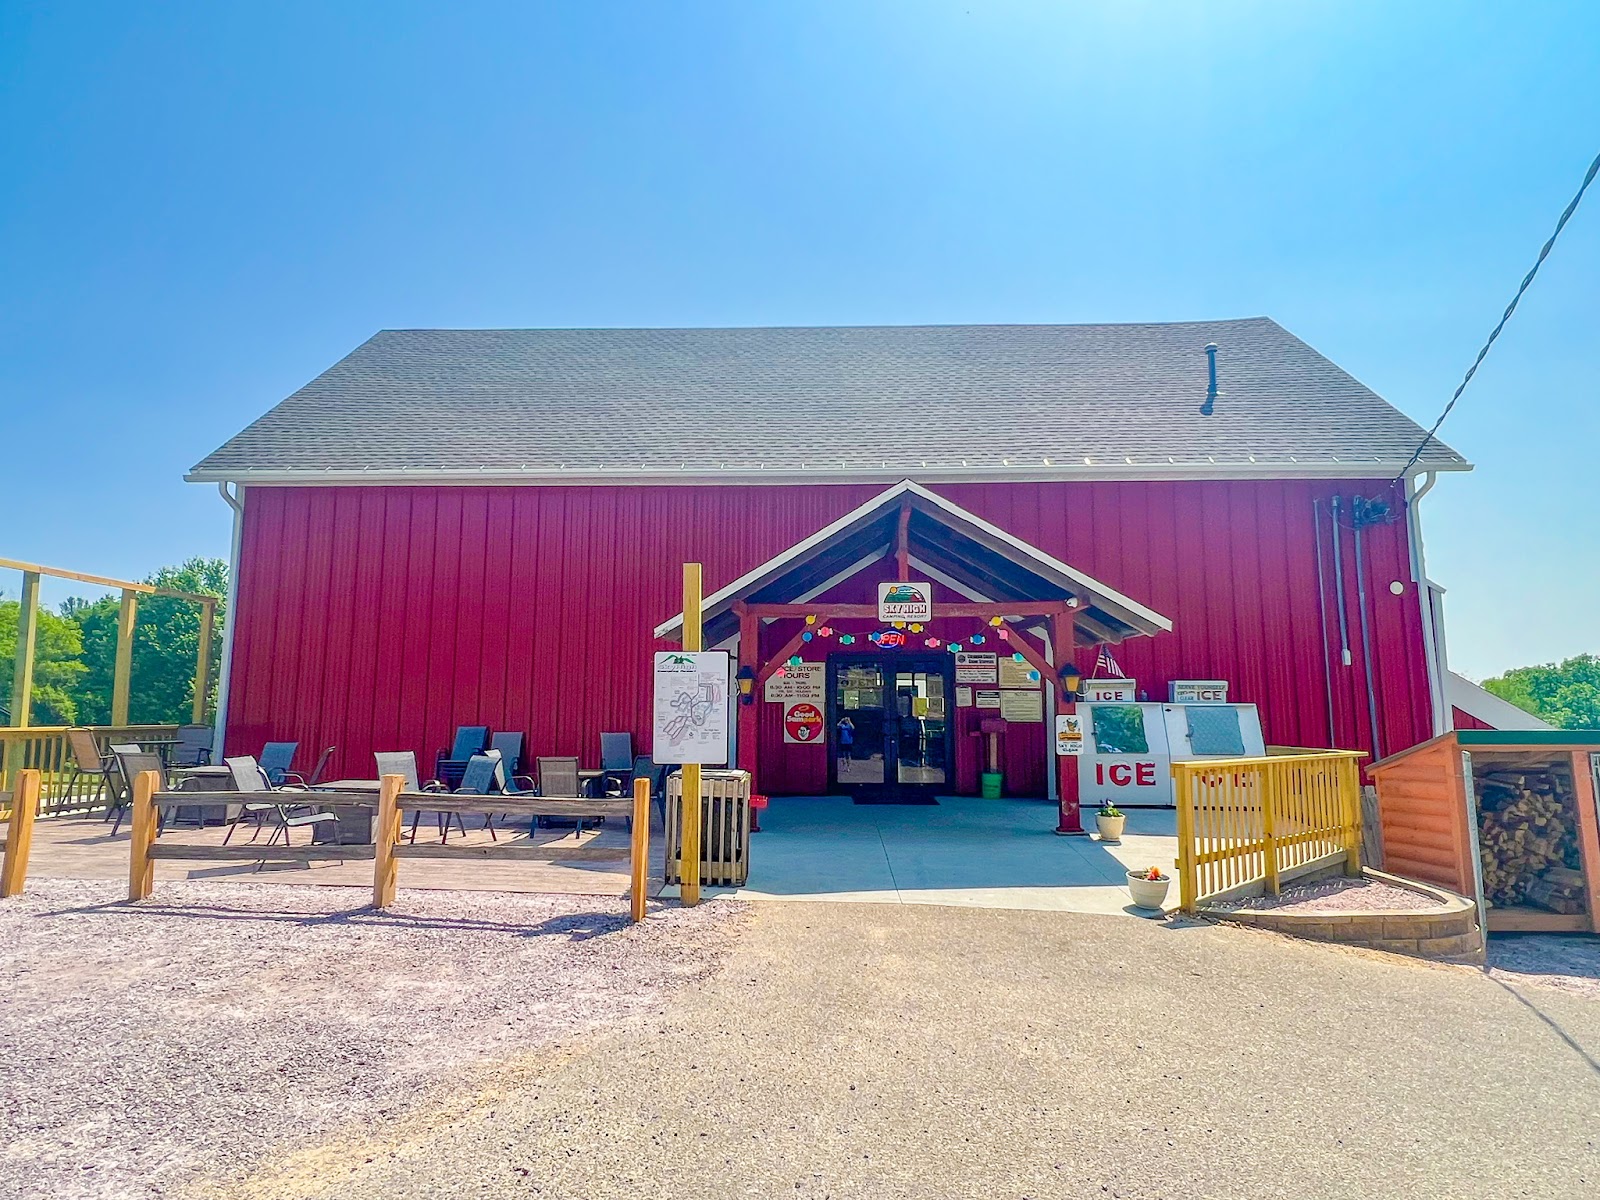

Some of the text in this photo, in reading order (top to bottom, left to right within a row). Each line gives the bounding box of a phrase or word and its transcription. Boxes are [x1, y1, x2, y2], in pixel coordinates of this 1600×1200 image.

[1096, 692, 1124, 700] ICE
[1198, 690, 1222, 700] ICE
[1096, 762, 1136, 786] ICE
